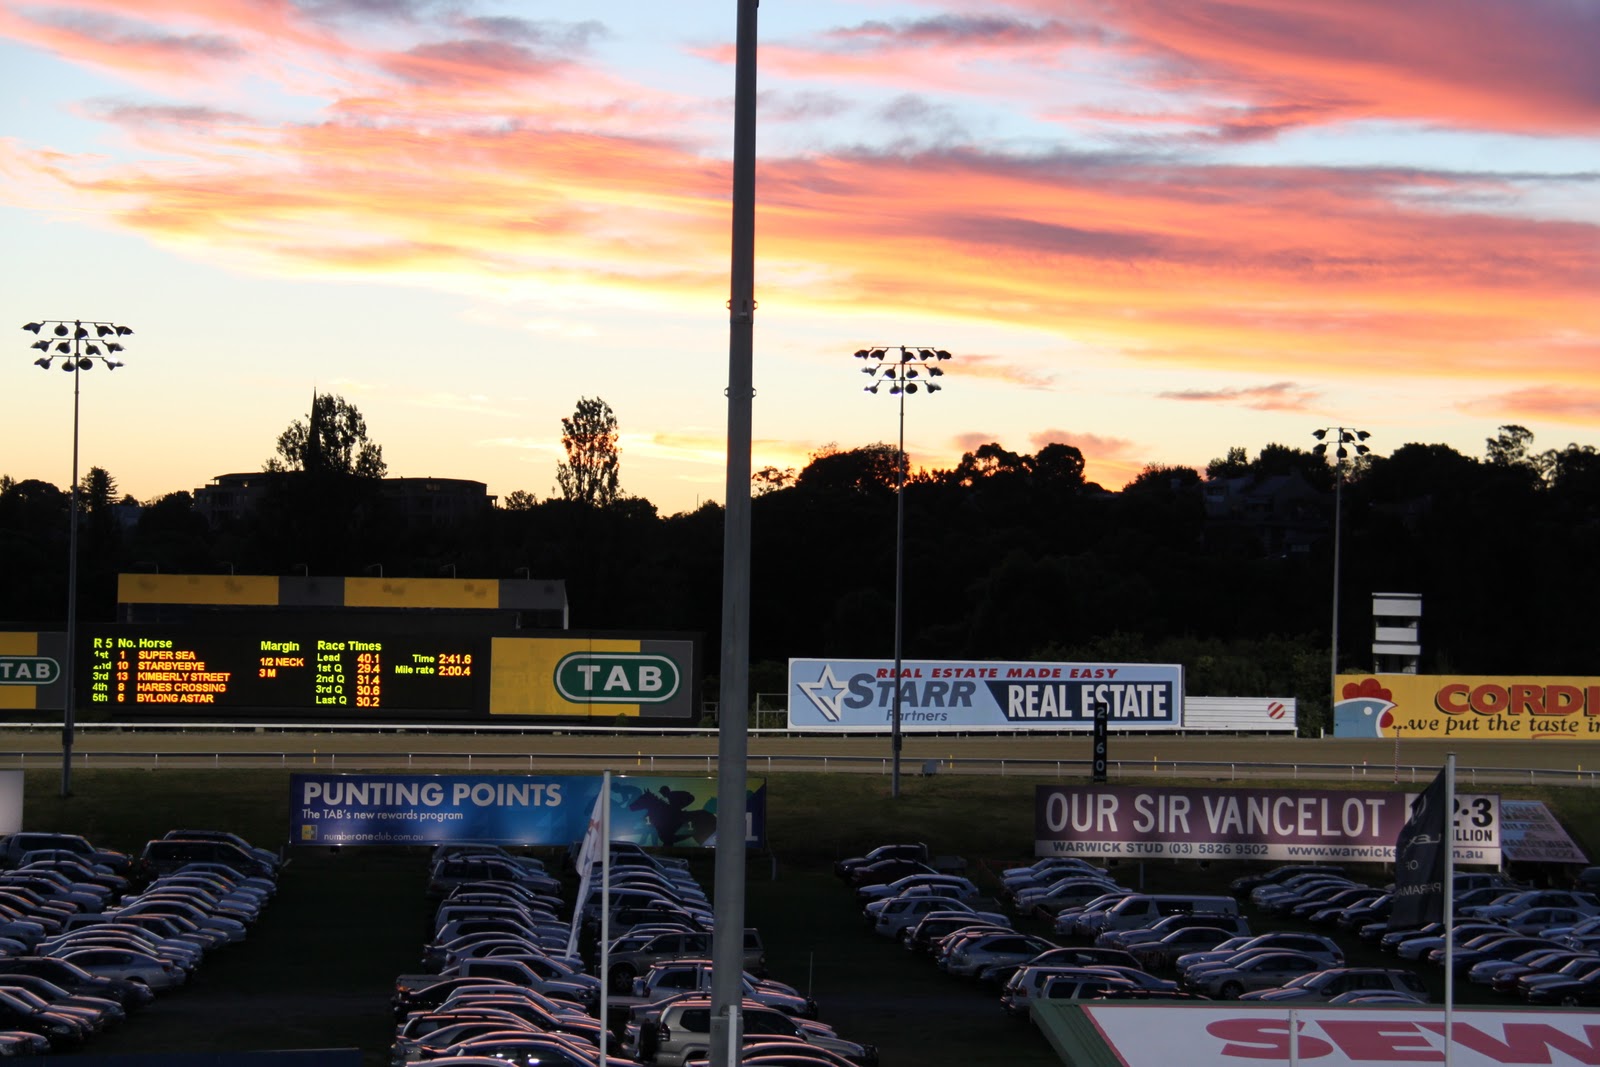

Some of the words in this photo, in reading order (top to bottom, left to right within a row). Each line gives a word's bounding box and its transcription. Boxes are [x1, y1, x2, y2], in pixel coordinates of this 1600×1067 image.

[93, 638, 102, 648] R
[105, 638, 113, 648] 5
[117, 638, 136, 648] No.
[138, 638, 172, 648] Horse
[260, 641, 299, 653] Margin
[317, 640, 345, 651] Race
[347, 641, 382, 651] Times
[94, 650, 109, 659] 1st
[119, 651, 126, 660] 1
[138, 651, 173, 660] SUPER
[175, 651, 196, 660] SEA
[317, 653, 341, 662] Lead
[357, 653, 379, 663] 40.1
[412, 654, 435, 663] Time
[438, 653, 472, 664] 2:41.6
[117, 661, 129, 670] 10
[138, 661, 205, 671] STARBYEBYE
[259, 657, 274, 666] 1/2
[275, 657, 304, 667] NECK
[0, 662, 51, 679] TAB
[259, 668, 265, 677] 3
[267, 668, 276, 677] M
[316, 663, 331, 672] 1st
[334, 664, 342, 673] Q
[357, 663, 380, 674] 29.4
[395, 665, 414, 674] Mile
[415, 665, 435, 674] rate
[438, 665, 471, 676] 2:00.4
[876, 668, 923, 679] REAL
[931, 668, 999, 679] ESTATE
[1006, 668, 1062, 679] MADE
[1069, 668, 1119, 679] EASY
[92, 672, 109, 680] 3rd
[117, 672, 129, 681] 13
[137, 672, 188, 681] KIMBERLY
[190, 672, 230, 681] STREET
[316, 674, 334, 683] 2nd
[336, 675, 345, 683] Q
[357, 674, 380, 685] 31.4
[577, 665, 663, 692] TAB
[92, 683, 108, 691] 4th
[117, 682, 125, 691] 8
[137, 683, 172, 692] HARES
[173, 683, 227, 693] CROSSING
[315, 685, 332, 694] 3rd
[334, 685, 343, 694] Q
[356, 685, 380, 696] 30.6
[843, 673, 977, 710] STARR
[92, 693, 108, 702] 5th
[117, 693, 124, 702] 6
[136, 693, 179, 703] BYLONG
[180, 693, 214, 703] ASTAR
[315, 695, 336, 704] Last
[338, 696, 347, 705] Q
[356, 696, 380, 707] 30.2
[1008, 684, 1073, 718] REAL
[1081, 684, 1167, 718] ESTATE
[1445, 716, 1480, 735] put
[1487, 714, 1521, 732] the
[1529, 717, 1580, 732] taste
[303, 781, 445, 807] PUNTING
[453, 782, 562, 807] POINTS
[302, 808, 321, 820] The
[353, 811, 375, 820] new
[377, 809, 418, 821] rewards
[419, 811, 464, 823] program
[1046, 792, 1119, 833] OUR
[1132, 793, 1191, 834] SIR
[1202, 795, 1386, 838] VANCELOT
[324, 832, 424, 841] numberoneclub.com.au
[1053, 841, 1122, 853] WARWICK
[1126, 842, 1164, 853] STUD
[1169, 842, 1193, 855] (03)
[1198, 843, 1231, 855] 5826
[1236, 845, 1269, 855] 9502
